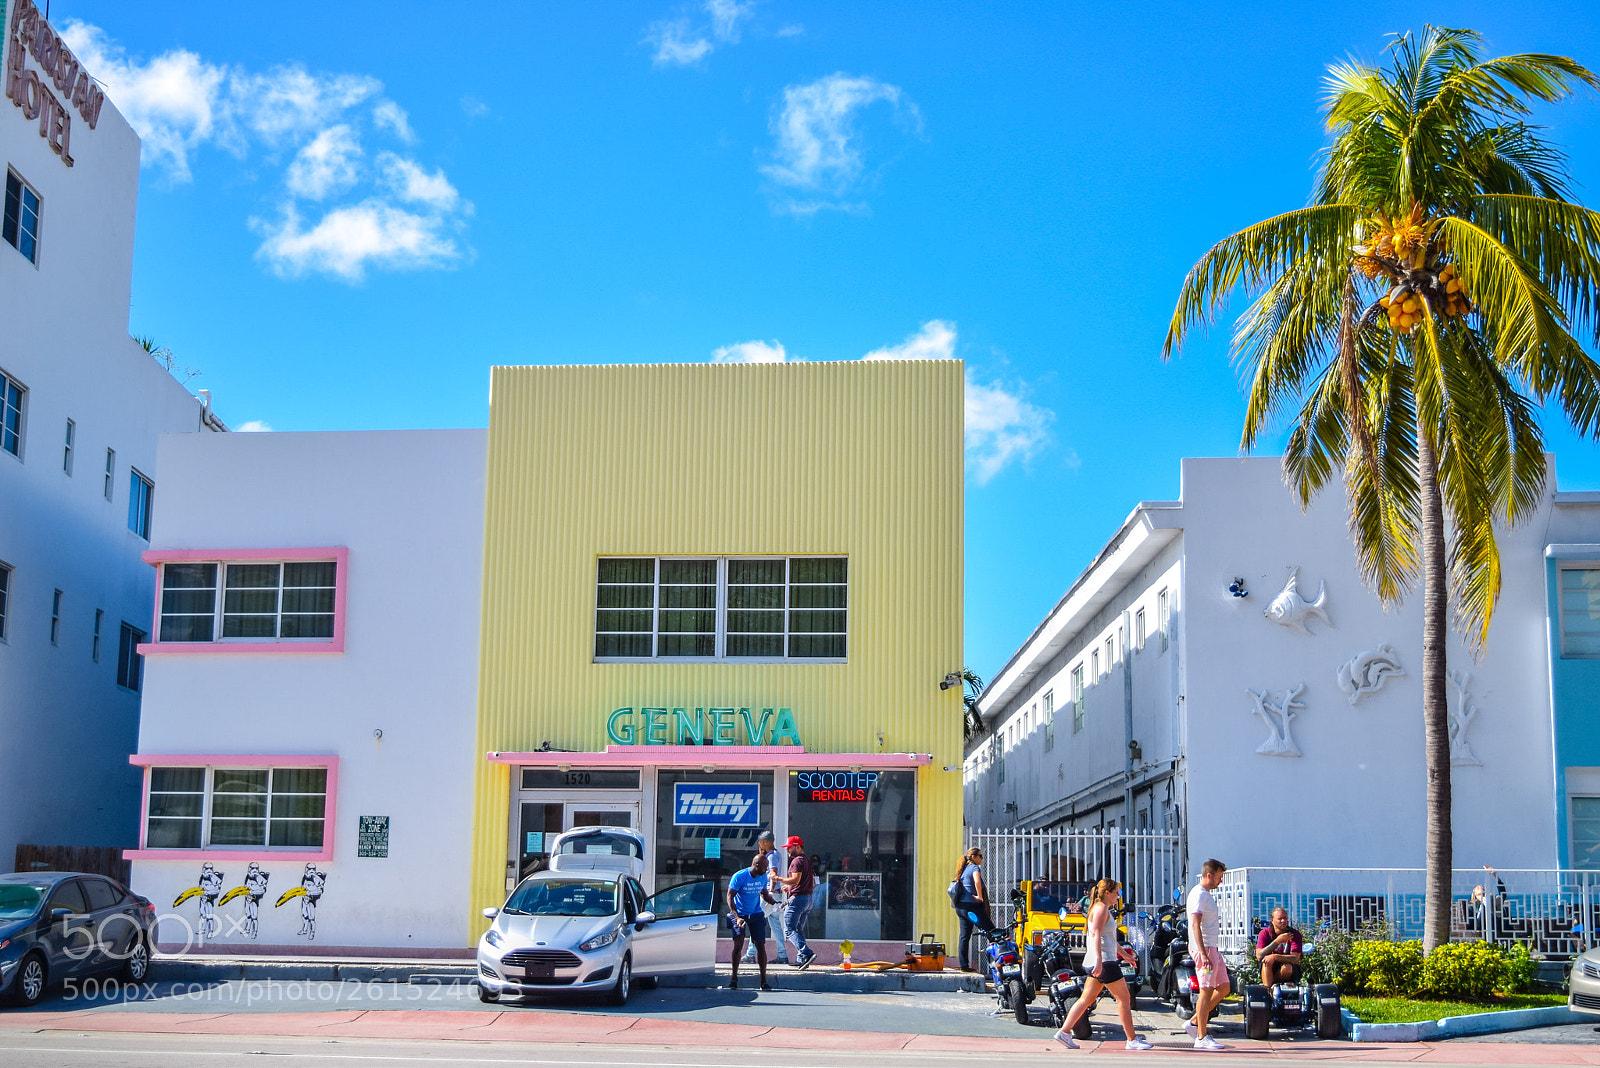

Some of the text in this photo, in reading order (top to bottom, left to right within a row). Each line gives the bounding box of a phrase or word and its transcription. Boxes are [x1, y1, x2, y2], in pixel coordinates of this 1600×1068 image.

[11, 0, 104, 130] PARISIAN
[6, 34, 74, 168] HOTEL
[607, 707, 803, 746] GENEVA
[564, 773, 591, 785] 1520
[798, 772, 878, 789] SCOOTER
[812, 789, 866, 801] RENTALS
[679, 793, 755, 822] Thrifty
[368, 824, 381, 833] ZONE
